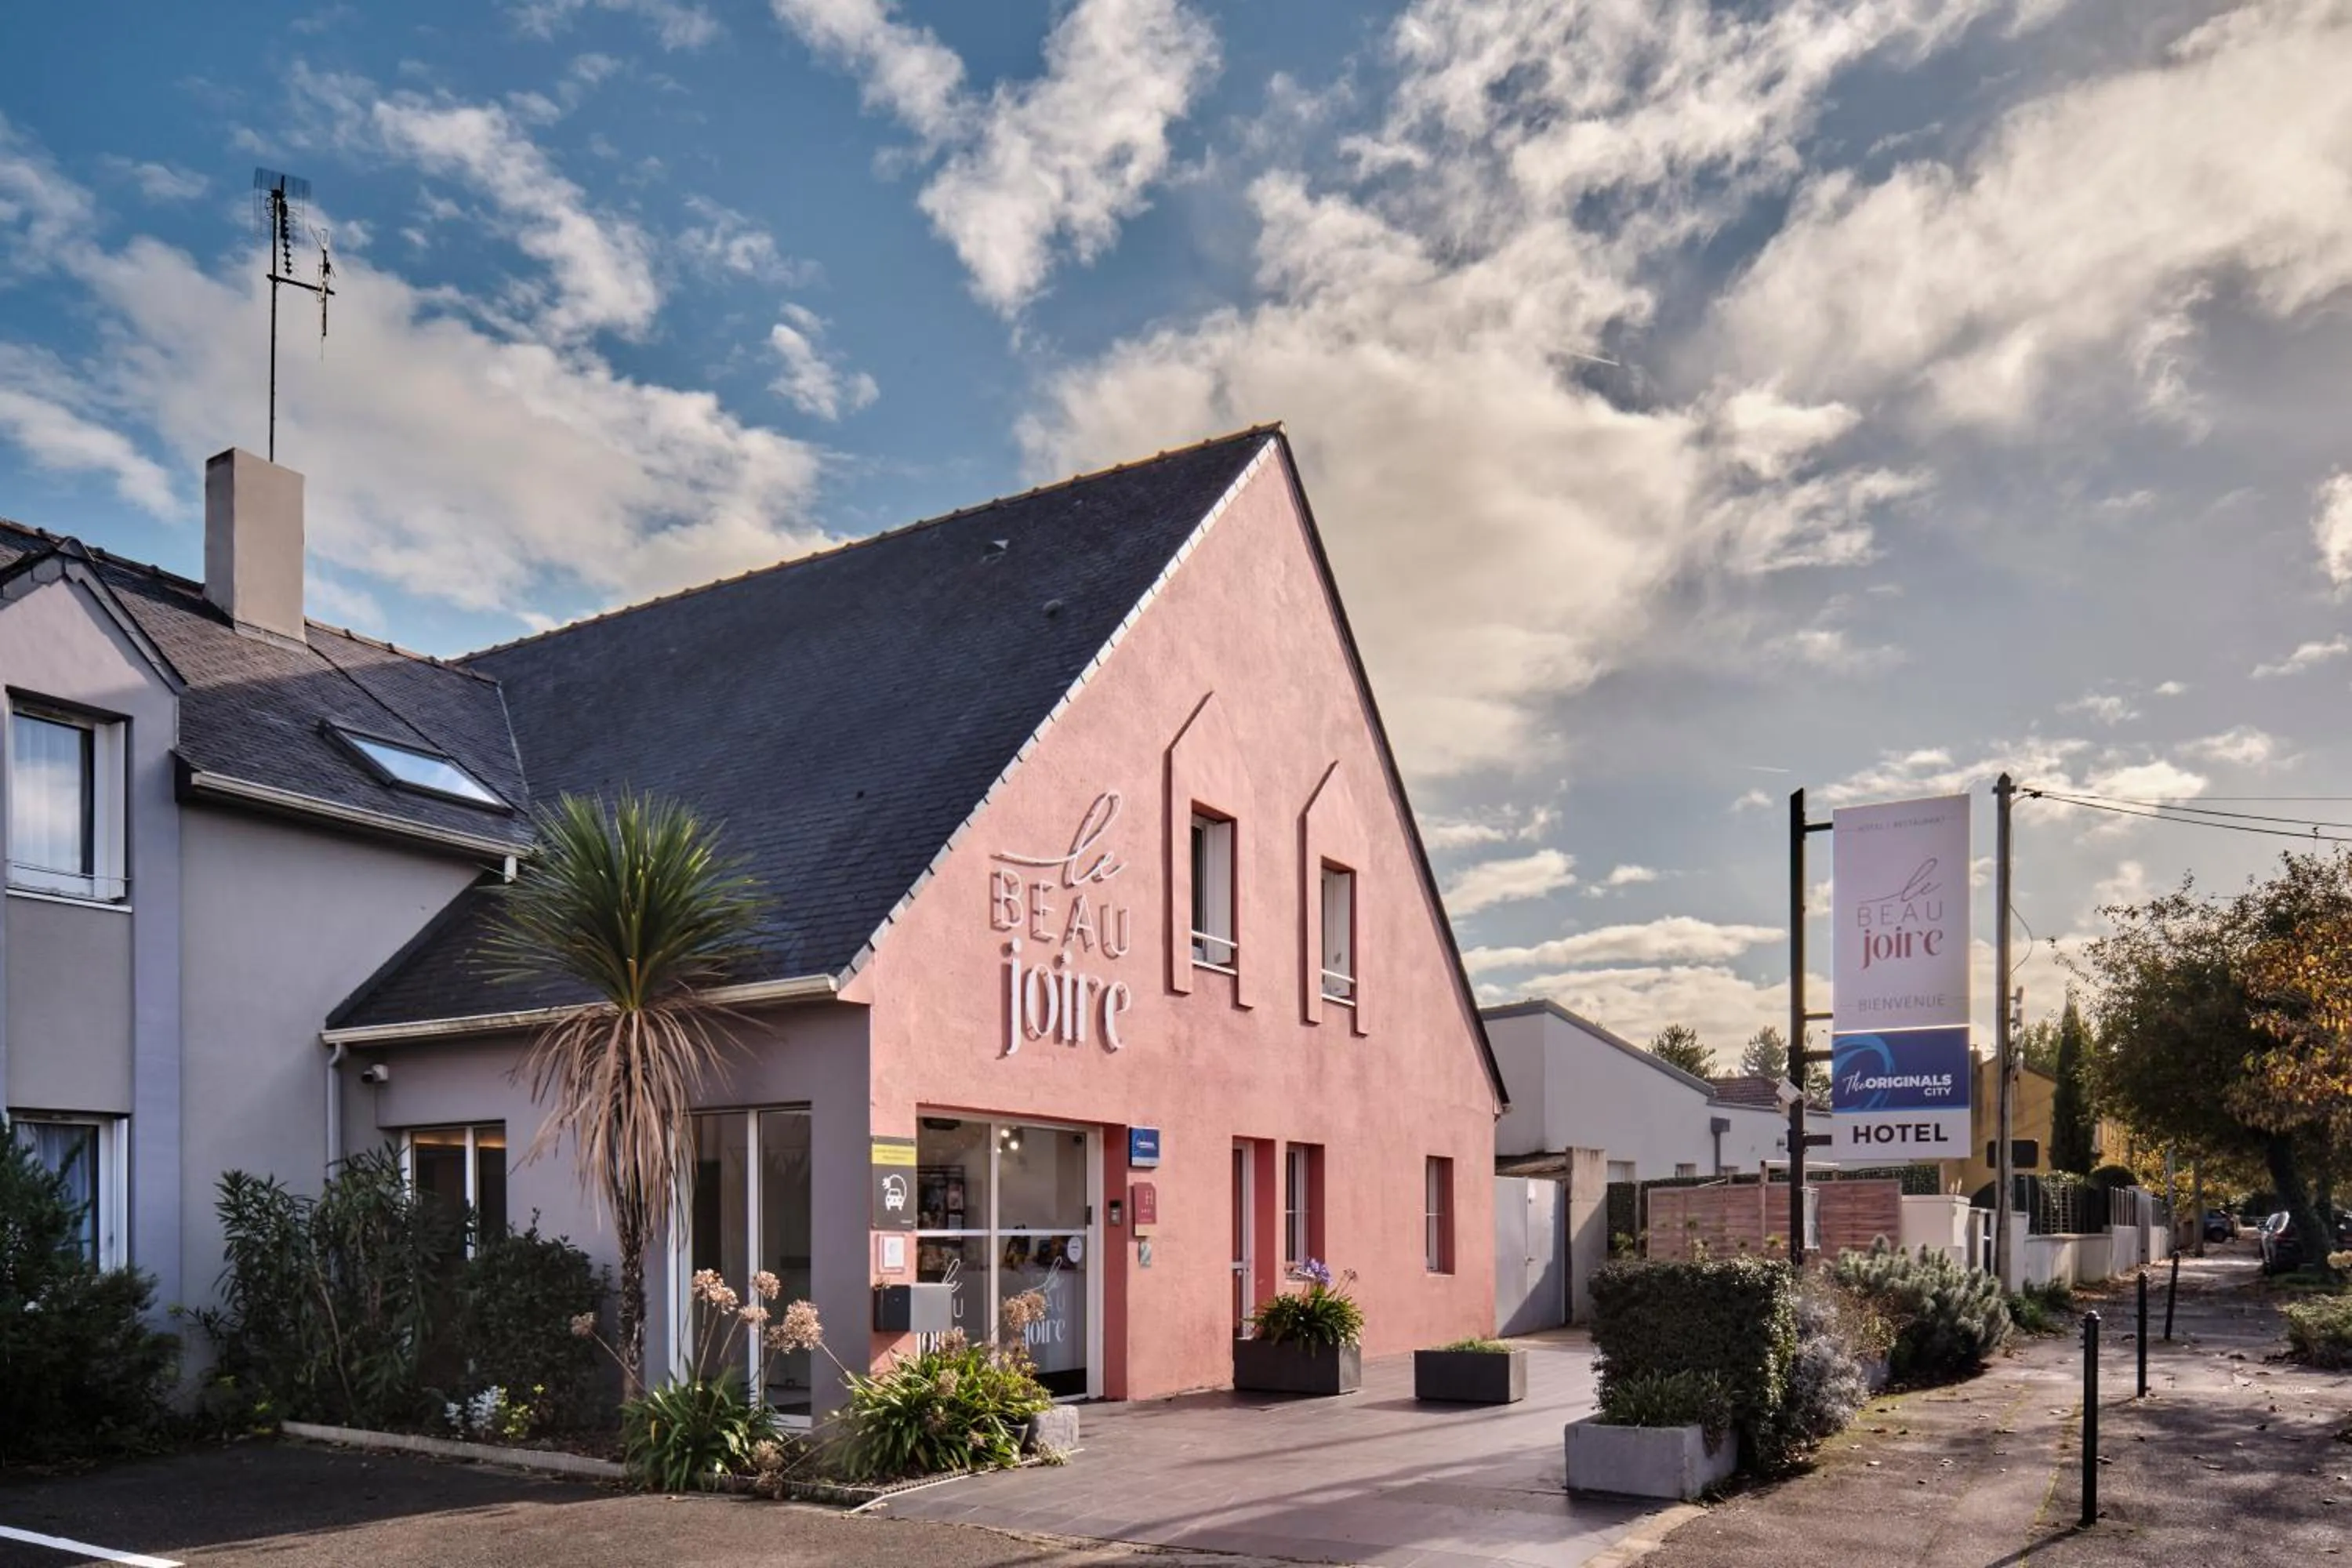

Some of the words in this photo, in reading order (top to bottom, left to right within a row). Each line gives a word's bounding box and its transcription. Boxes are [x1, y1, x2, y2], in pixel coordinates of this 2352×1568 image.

[1000, 789, 1127, 885] le
[1862, 857, 1943, 902] le
[1000, 868, 1131, 956] BEAU
[1857, 899, 1944, 927] BEAU
[1860, 925, 1944, 970] joire
[1004, 936, 1131, 1055] joire
[1858, 993, 1946, 1012] BIENVENUE
[1842, 1070, 1866, 1096] The
[1865, 1074, 1952, 1089] ORIGINALS
[1924, 1087, 1951, 1097] CITY
[1853, 1123, 1948, 1144] HOTEL
